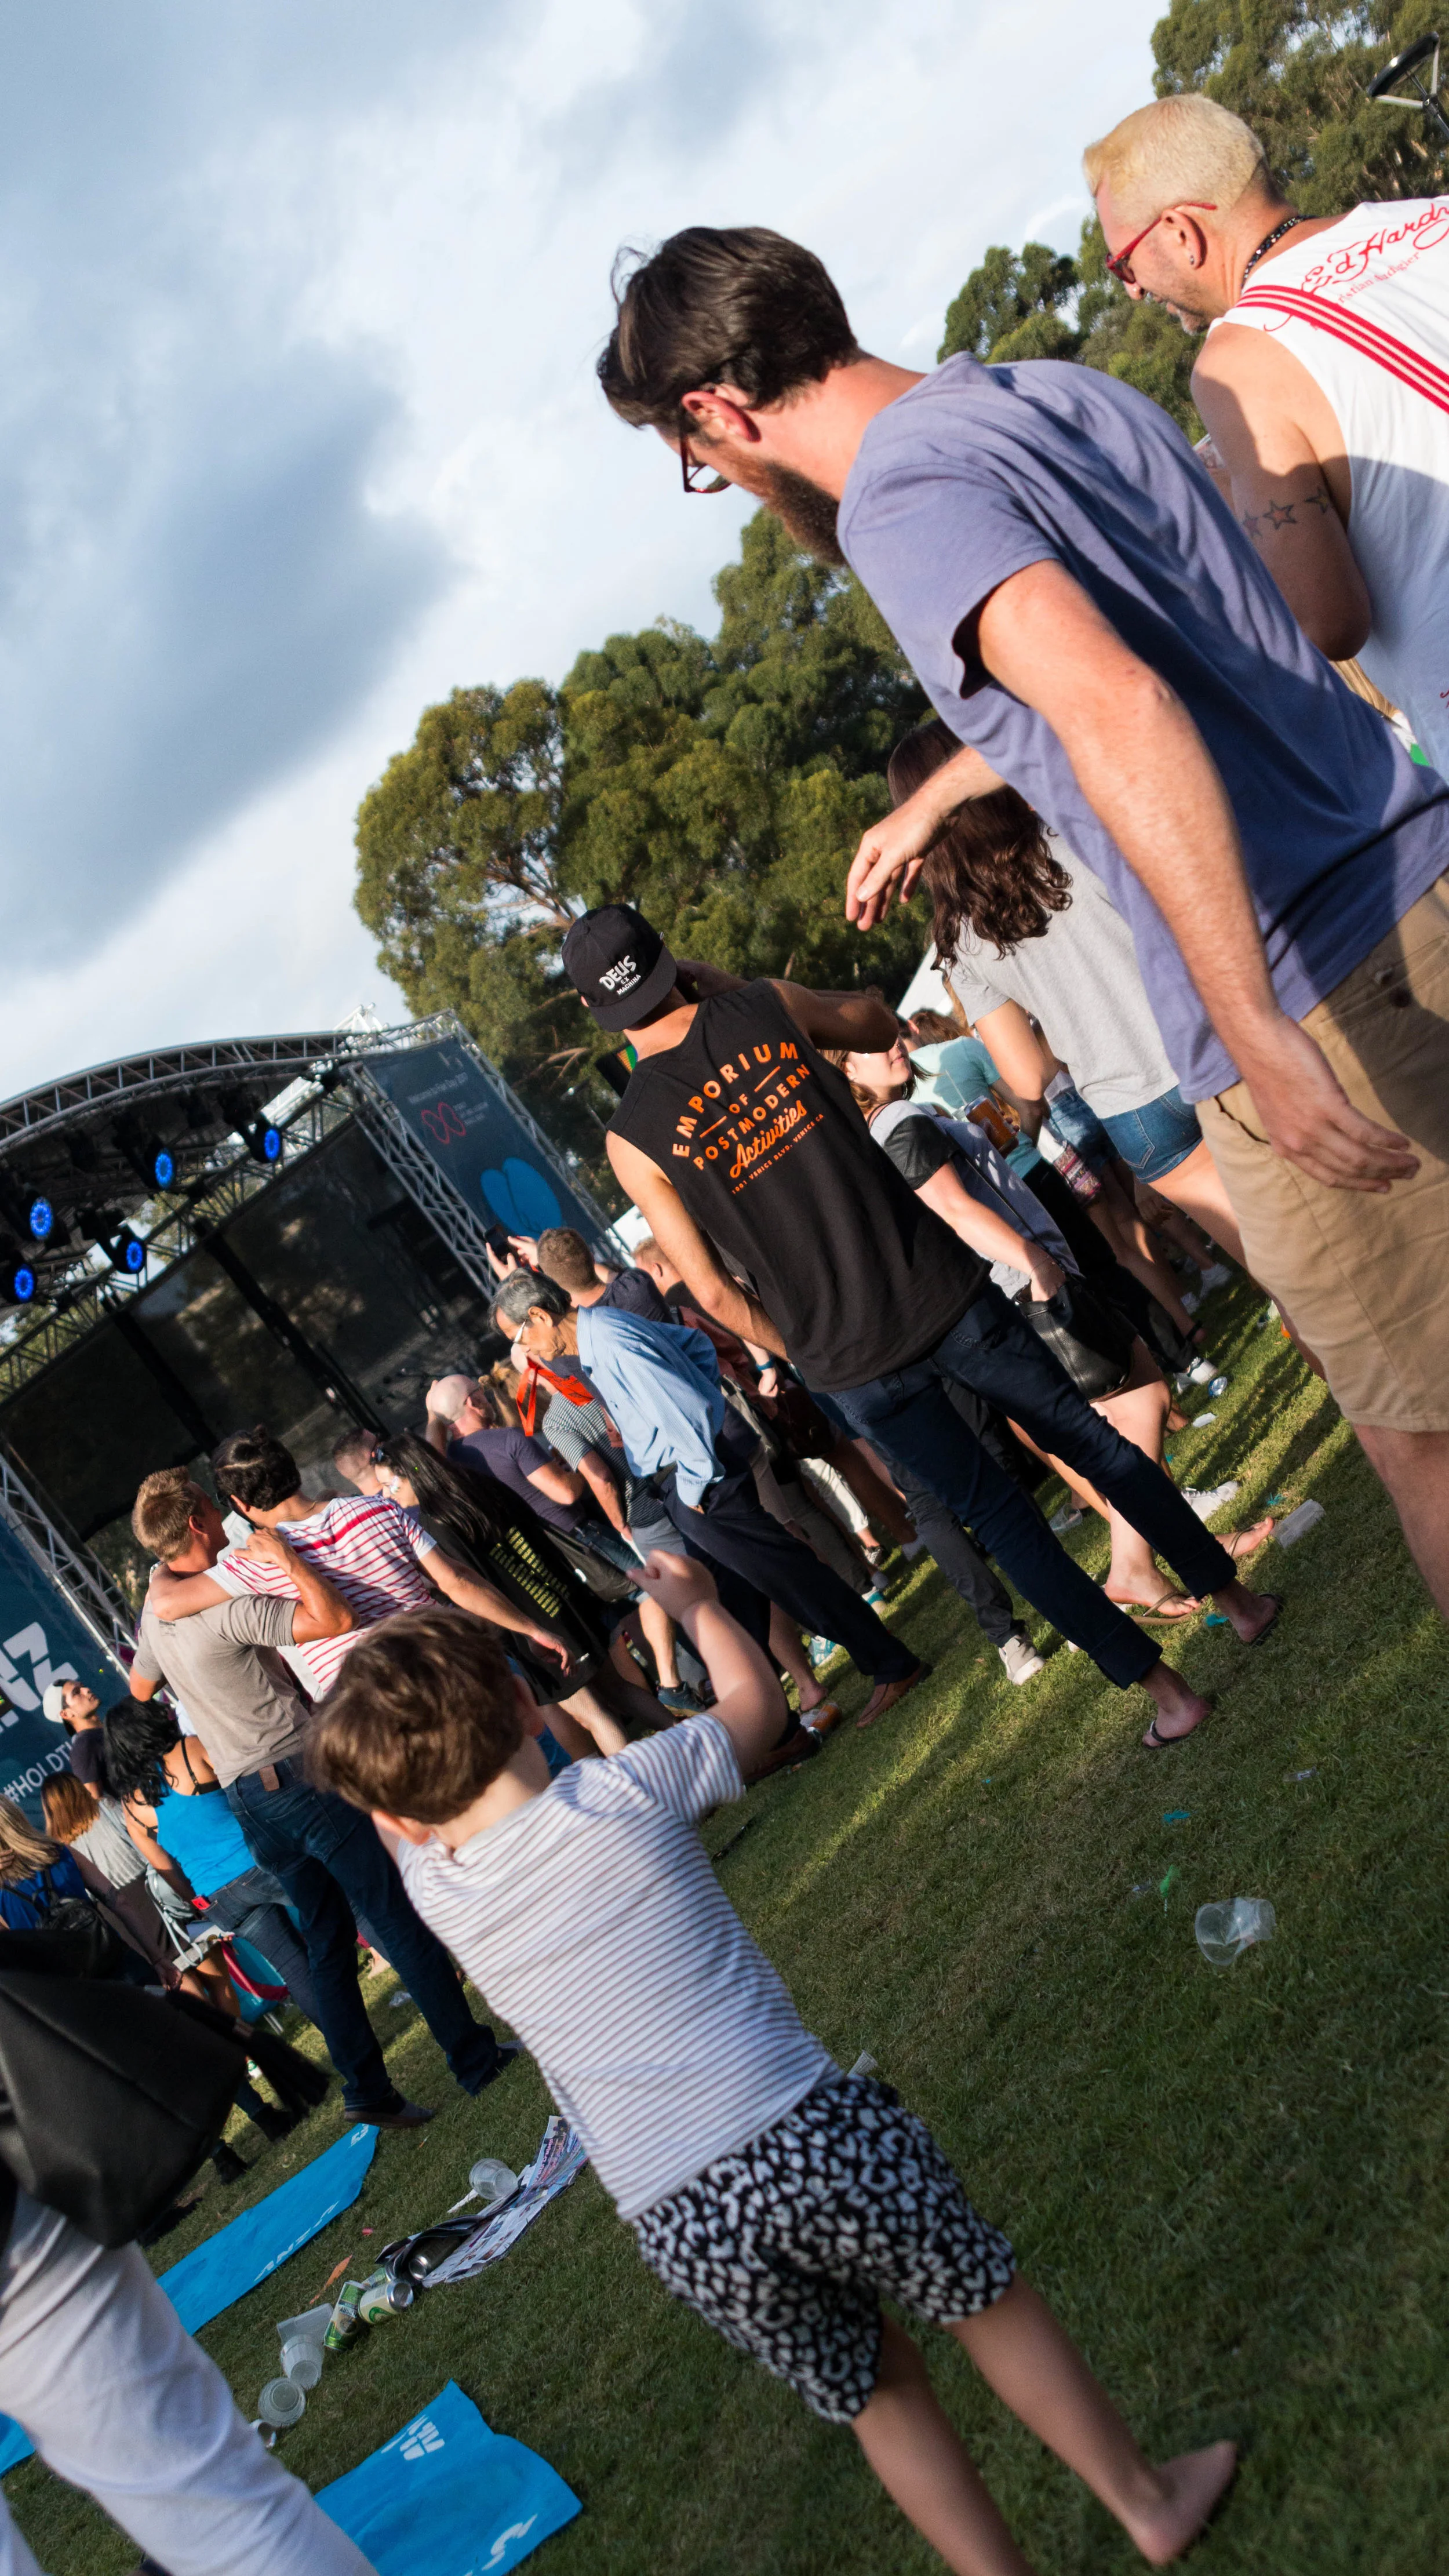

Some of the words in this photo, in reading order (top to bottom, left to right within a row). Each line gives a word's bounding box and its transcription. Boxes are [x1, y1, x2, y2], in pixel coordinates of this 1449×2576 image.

[599, 955, 636, 990] DEUS
[616, 974, 641, 995] MACHINA
[620, 976, 629, 984] EX
[672, 1042, 798, 1158] EMPORIUM
[693, 1064, 810, 1171] POSTMODERN
[729, 1093, 748, 1114] OF
[730, 1100, 807, 1178] Activities
[748, 1159, 773, 1180] VENICE
[793, 1120, 815, 1143] VENICE
[815, 1113, 824, 1122] CA
